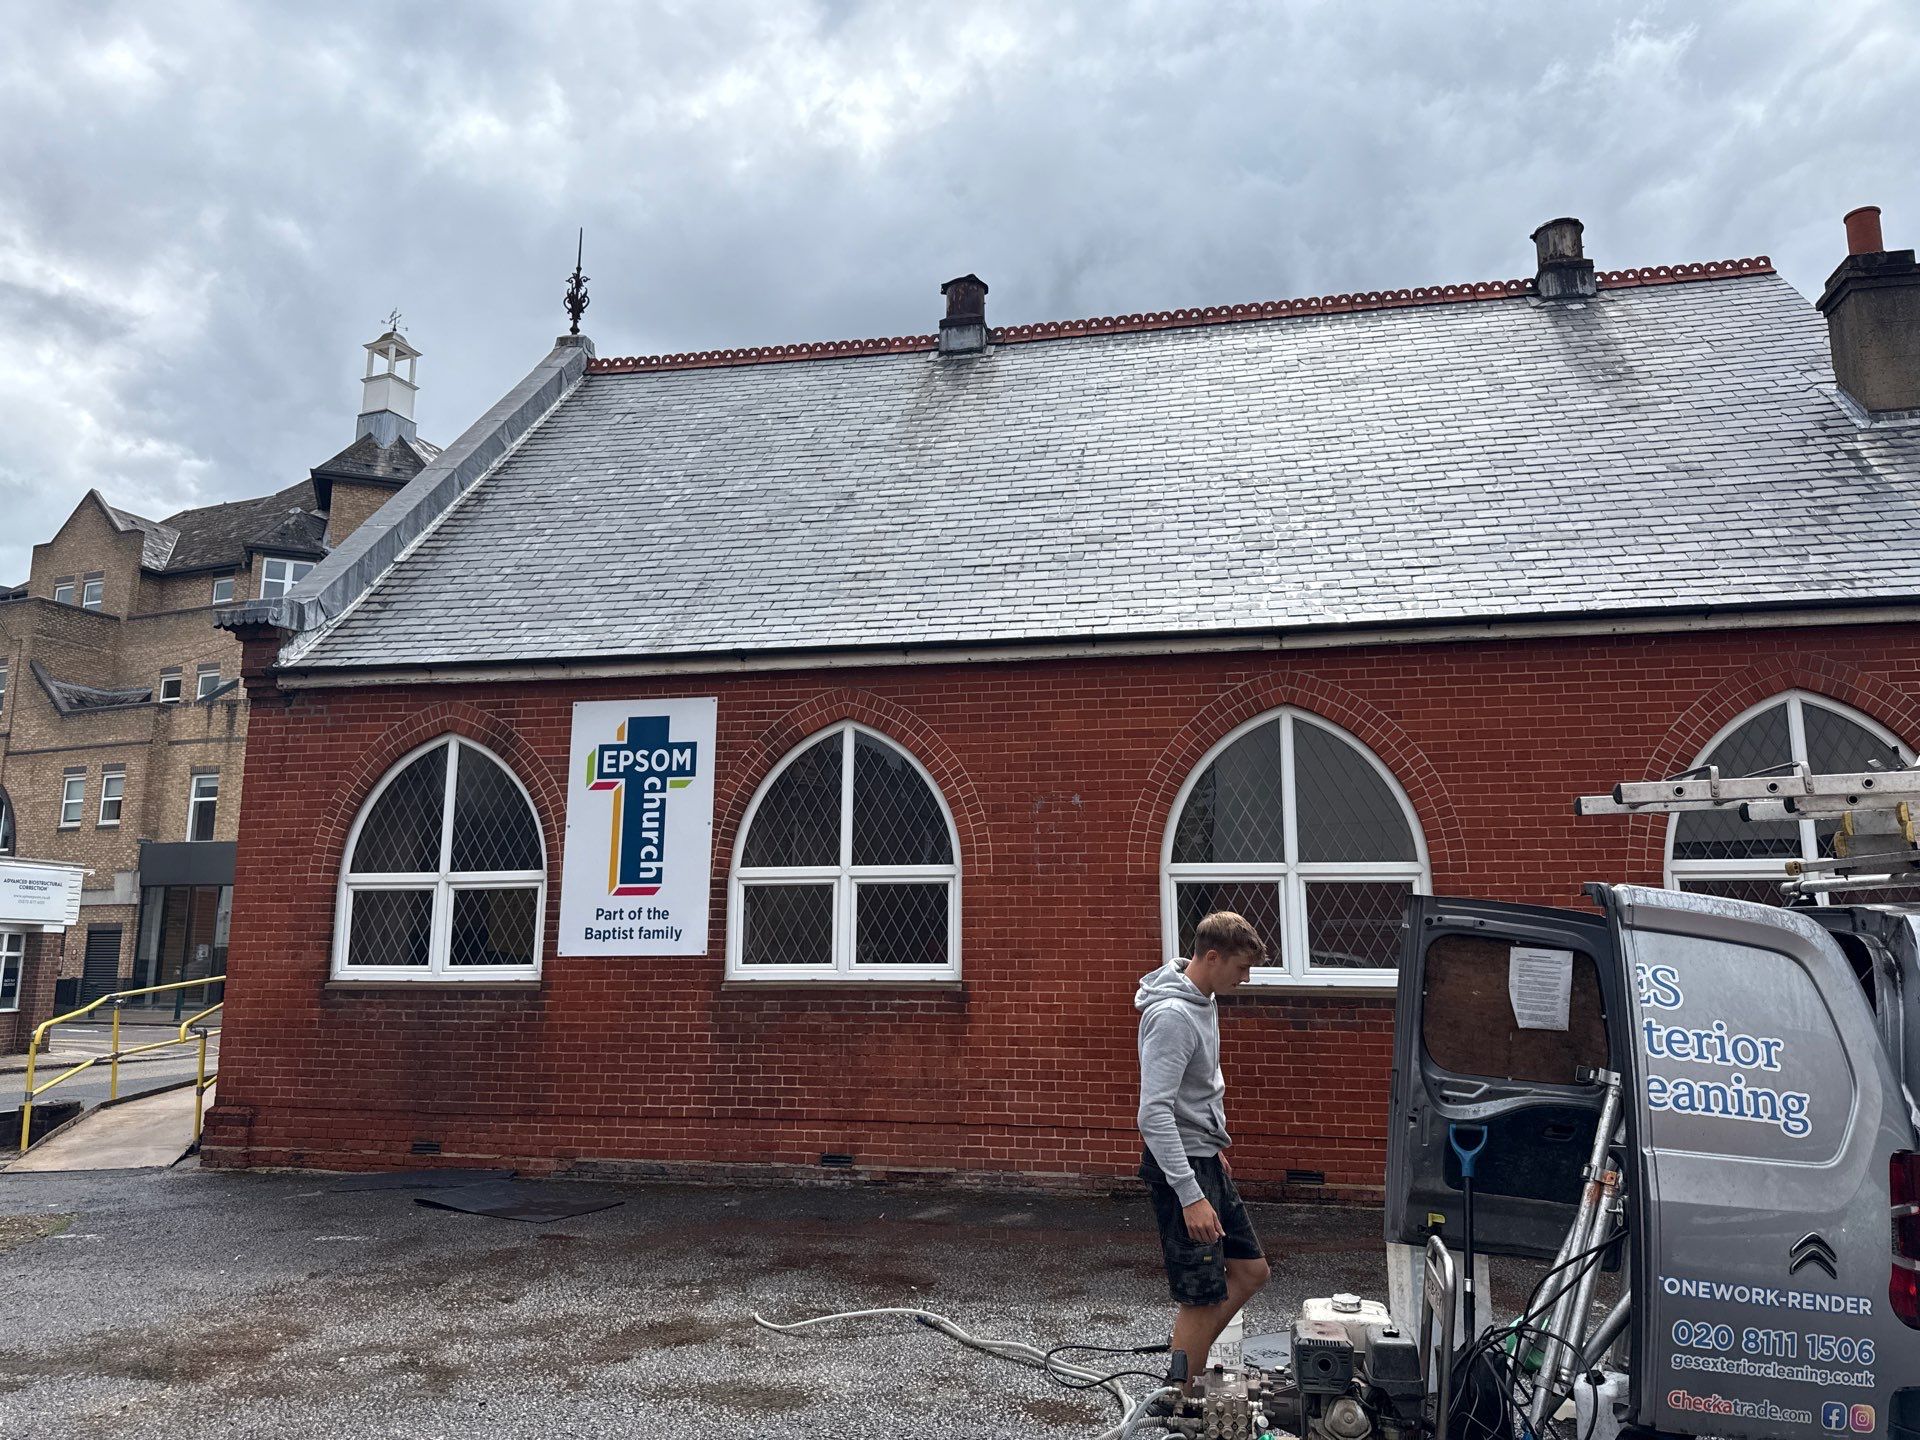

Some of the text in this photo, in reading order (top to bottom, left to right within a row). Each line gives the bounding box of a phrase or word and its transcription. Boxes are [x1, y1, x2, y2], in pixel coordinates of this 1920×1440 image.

[602, 748, 691, 773] EPSOM
[639, 776, 666, 879] church
[595, 907, 670, 920] Part of the
[584, 926, 683, 942] Baptist family
[1659, 1275, 1872, 1315] ONEWORK-RENDER
[1672, 1319, 1875, 1366] 020 8111 1506
[1671, 1353, 1875, 1388] gesexteriorcleaning.co.uk
